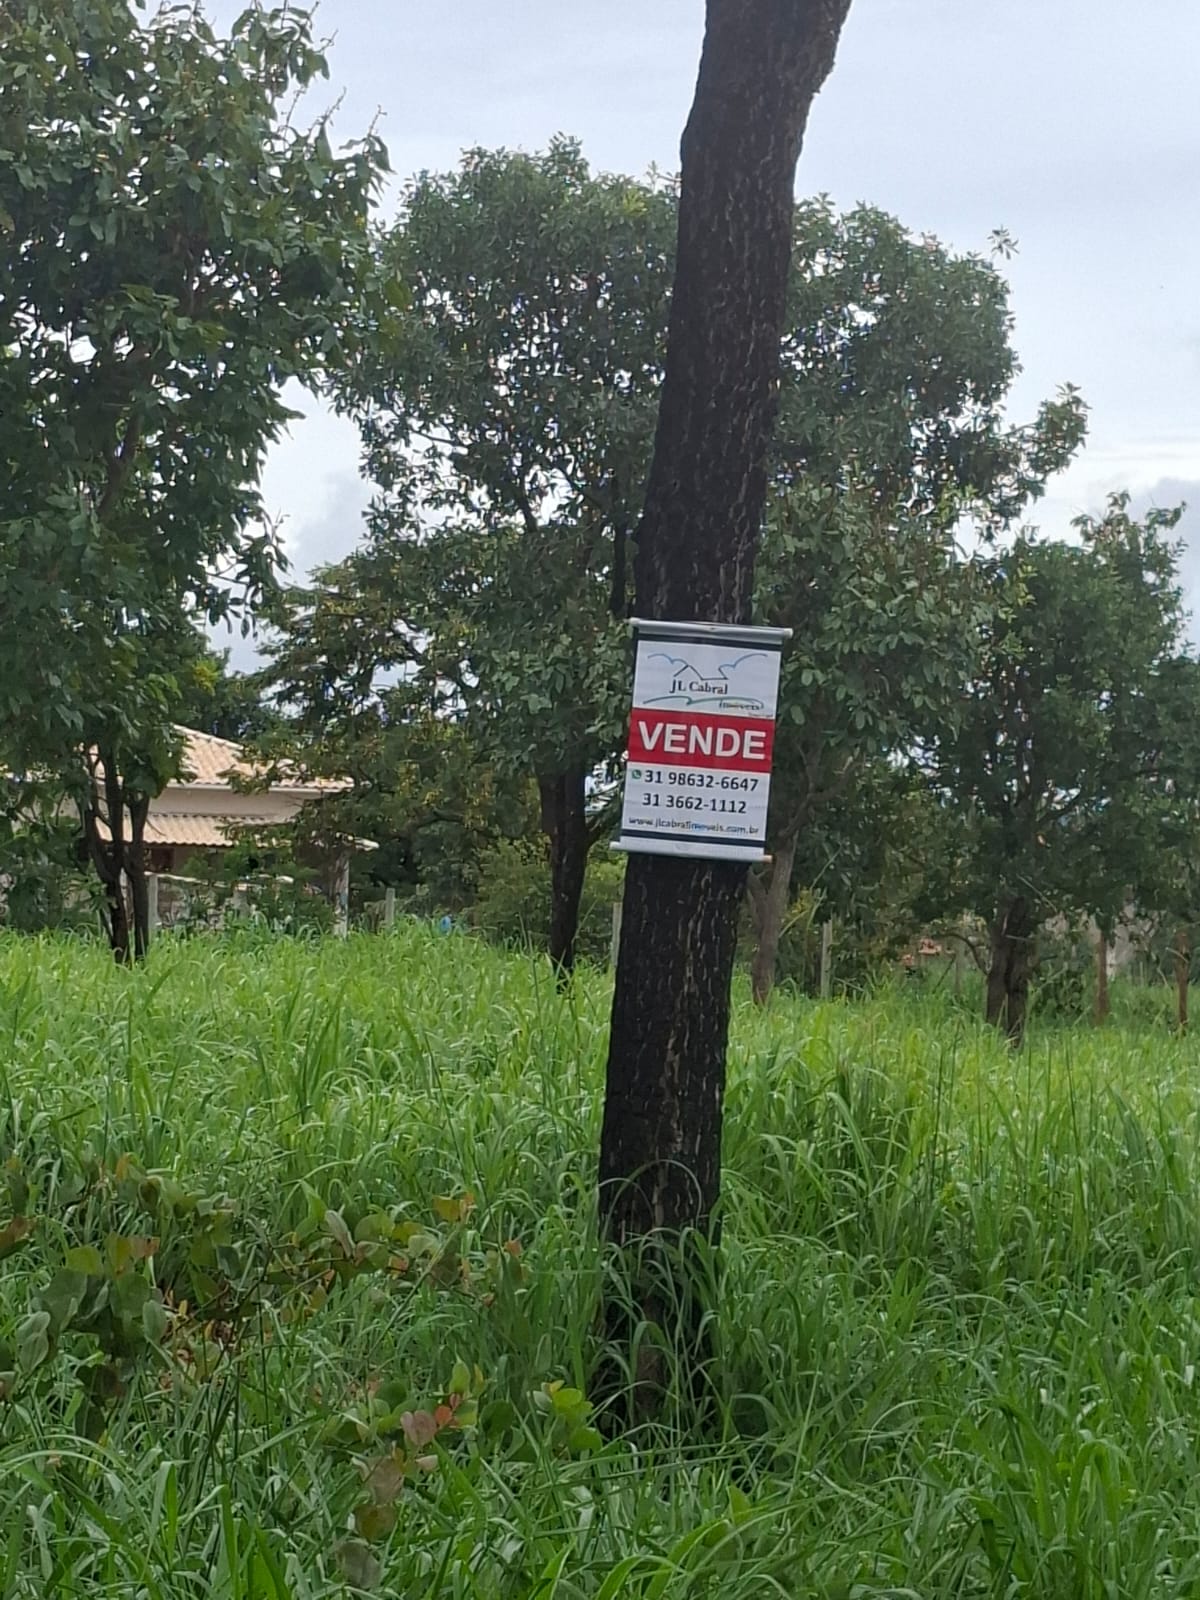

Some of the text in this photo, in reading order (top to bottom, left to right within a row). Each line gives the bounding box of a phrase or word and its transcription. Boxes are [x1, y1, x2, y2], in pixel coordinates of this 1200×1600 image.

[669, 679, 728, 695] JL Cabral
[638, 720, 766, 760] VENDE
[645, 769, 759, 792] 31 98632-6647
[642, 793, 747, 814] 31 3662-1112
